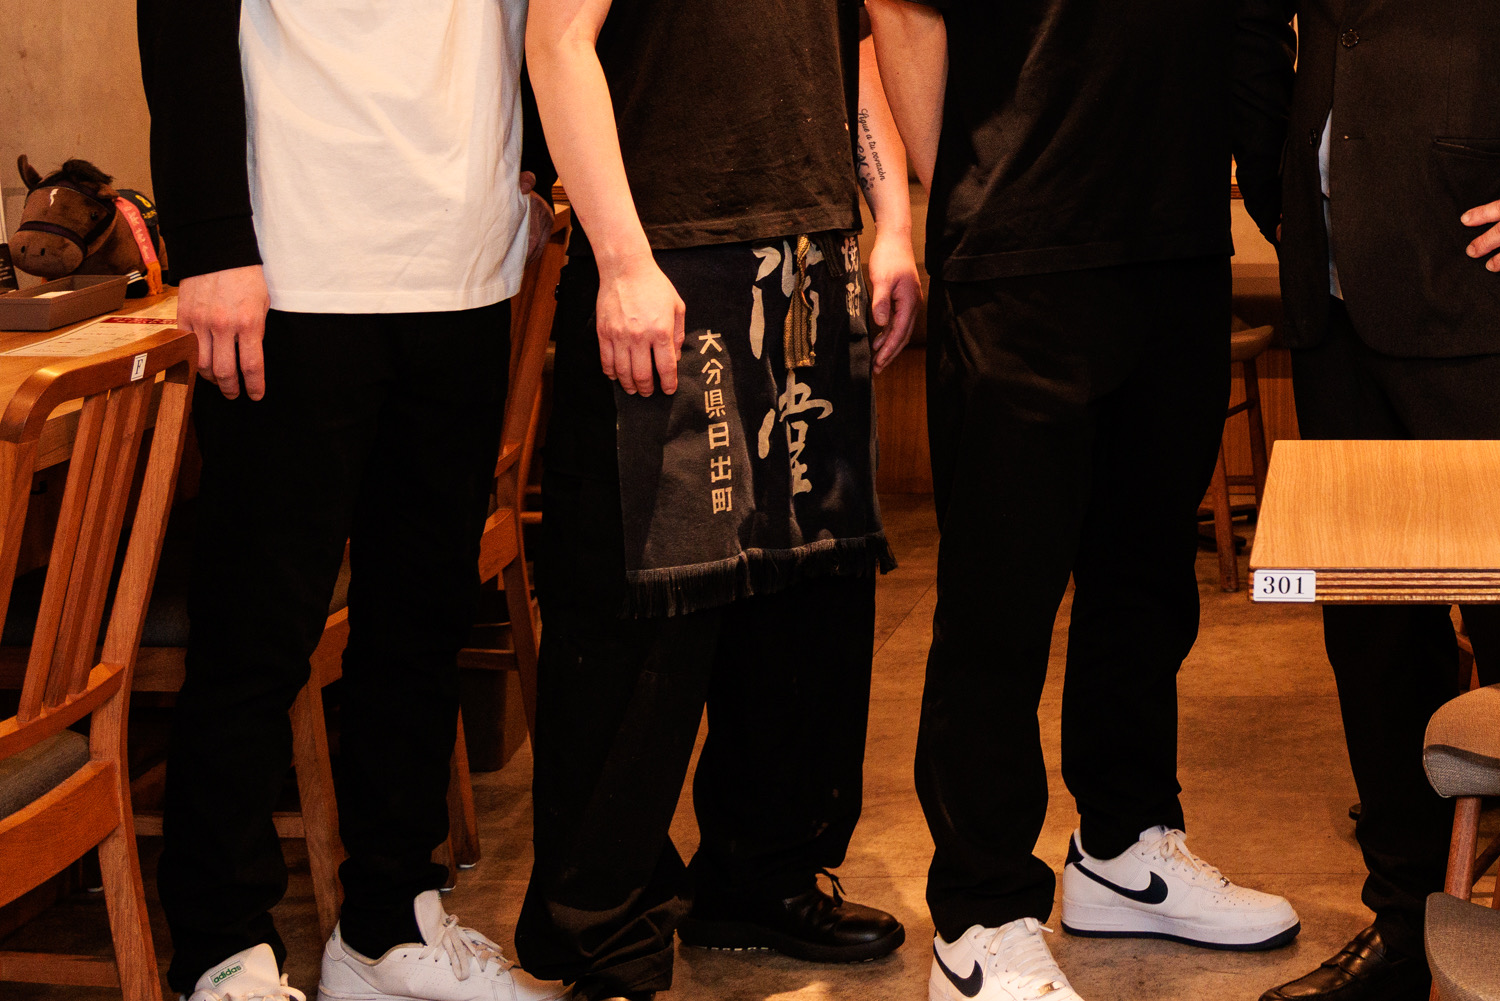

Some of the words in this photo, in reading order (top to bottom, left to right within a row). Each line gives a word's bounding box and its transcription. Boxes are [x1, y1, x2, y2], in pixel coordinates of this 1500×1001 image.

[134, 358, 145, 375] F
[698, 329, 733, 514] 大分県日出町
[1263, 576, 1304, 594] 301
[213, 965, 242, 984] adidas
